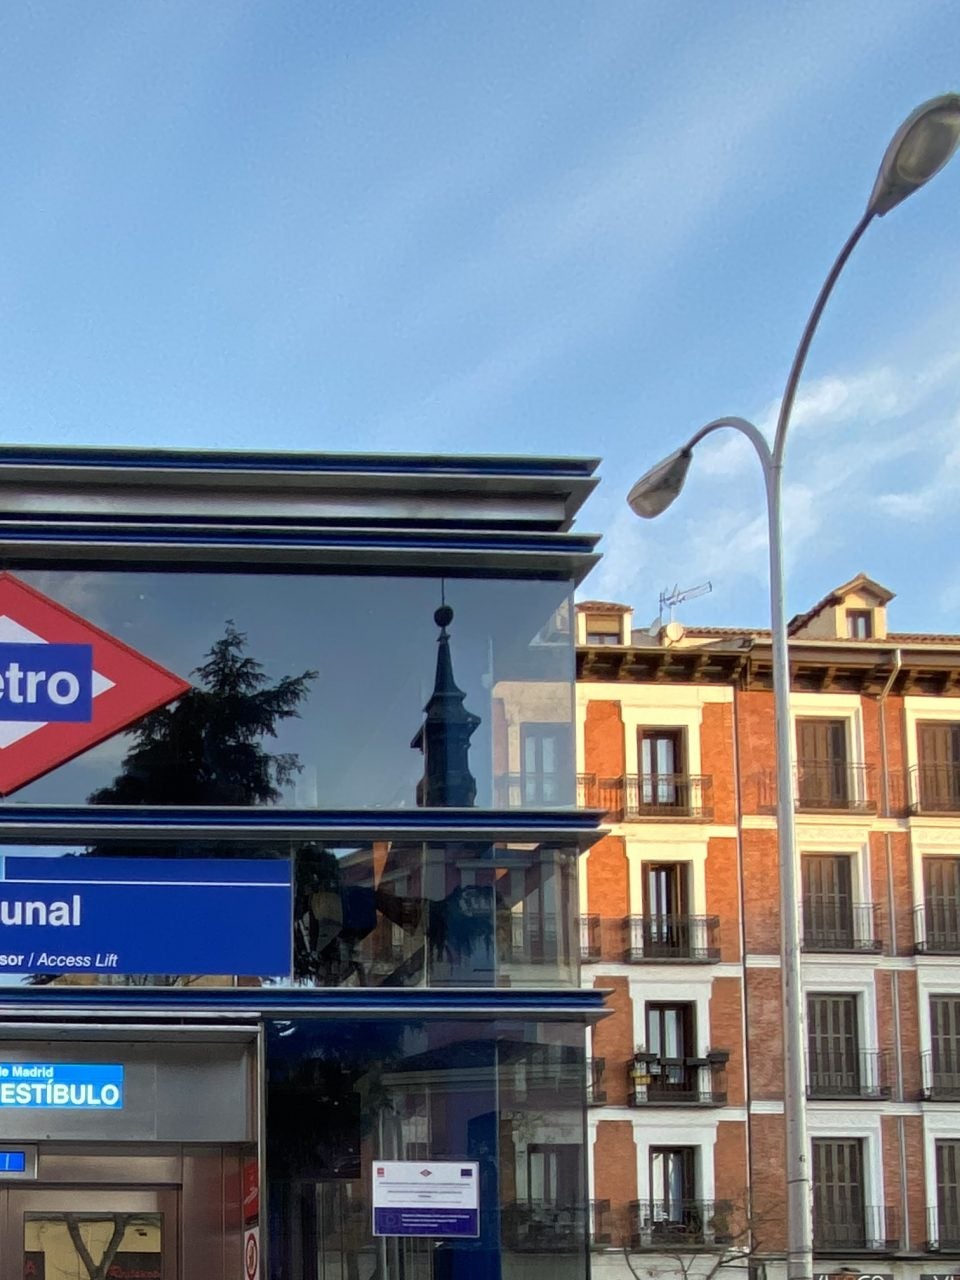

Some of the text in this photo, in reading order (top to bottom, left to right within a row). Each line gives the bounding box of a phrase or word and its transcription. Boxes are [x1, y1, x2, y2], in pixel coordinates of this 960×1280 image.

[28, 952, 34, 967] /
[37, 953, 91, 968] Access
[95, 953, 119, 968] Lift
[12, 1066, 54, 1078] Madrid
